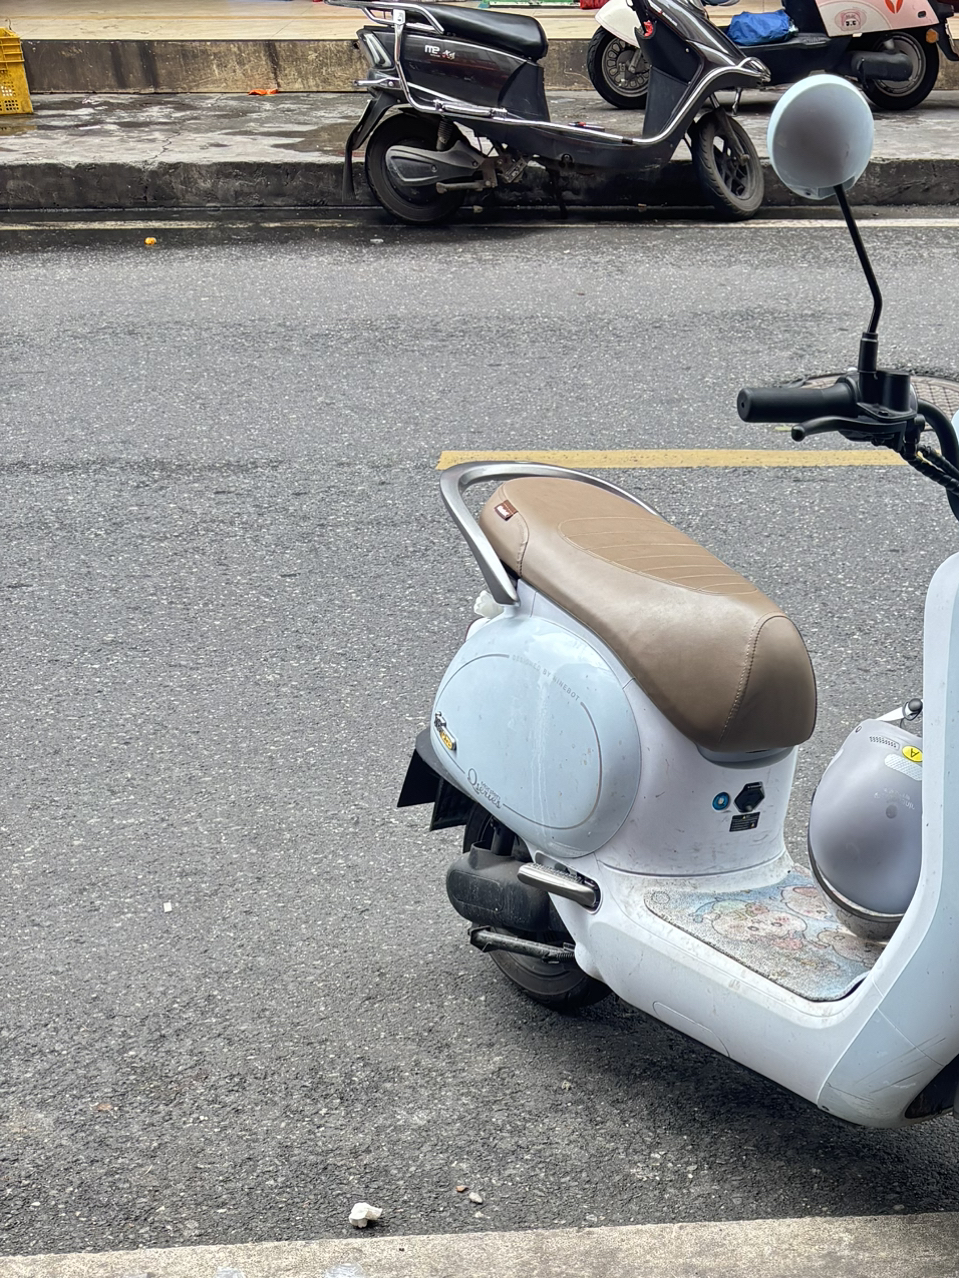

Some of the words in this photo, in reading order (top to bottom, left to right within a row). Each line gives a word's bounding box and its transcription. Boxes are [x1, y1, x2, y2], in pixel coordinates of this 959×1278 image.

[512, 654, 541, 672] DESIGNED
[542, 668, 551, 677] BY
[552, 675, 580, 701] NINEBOT
